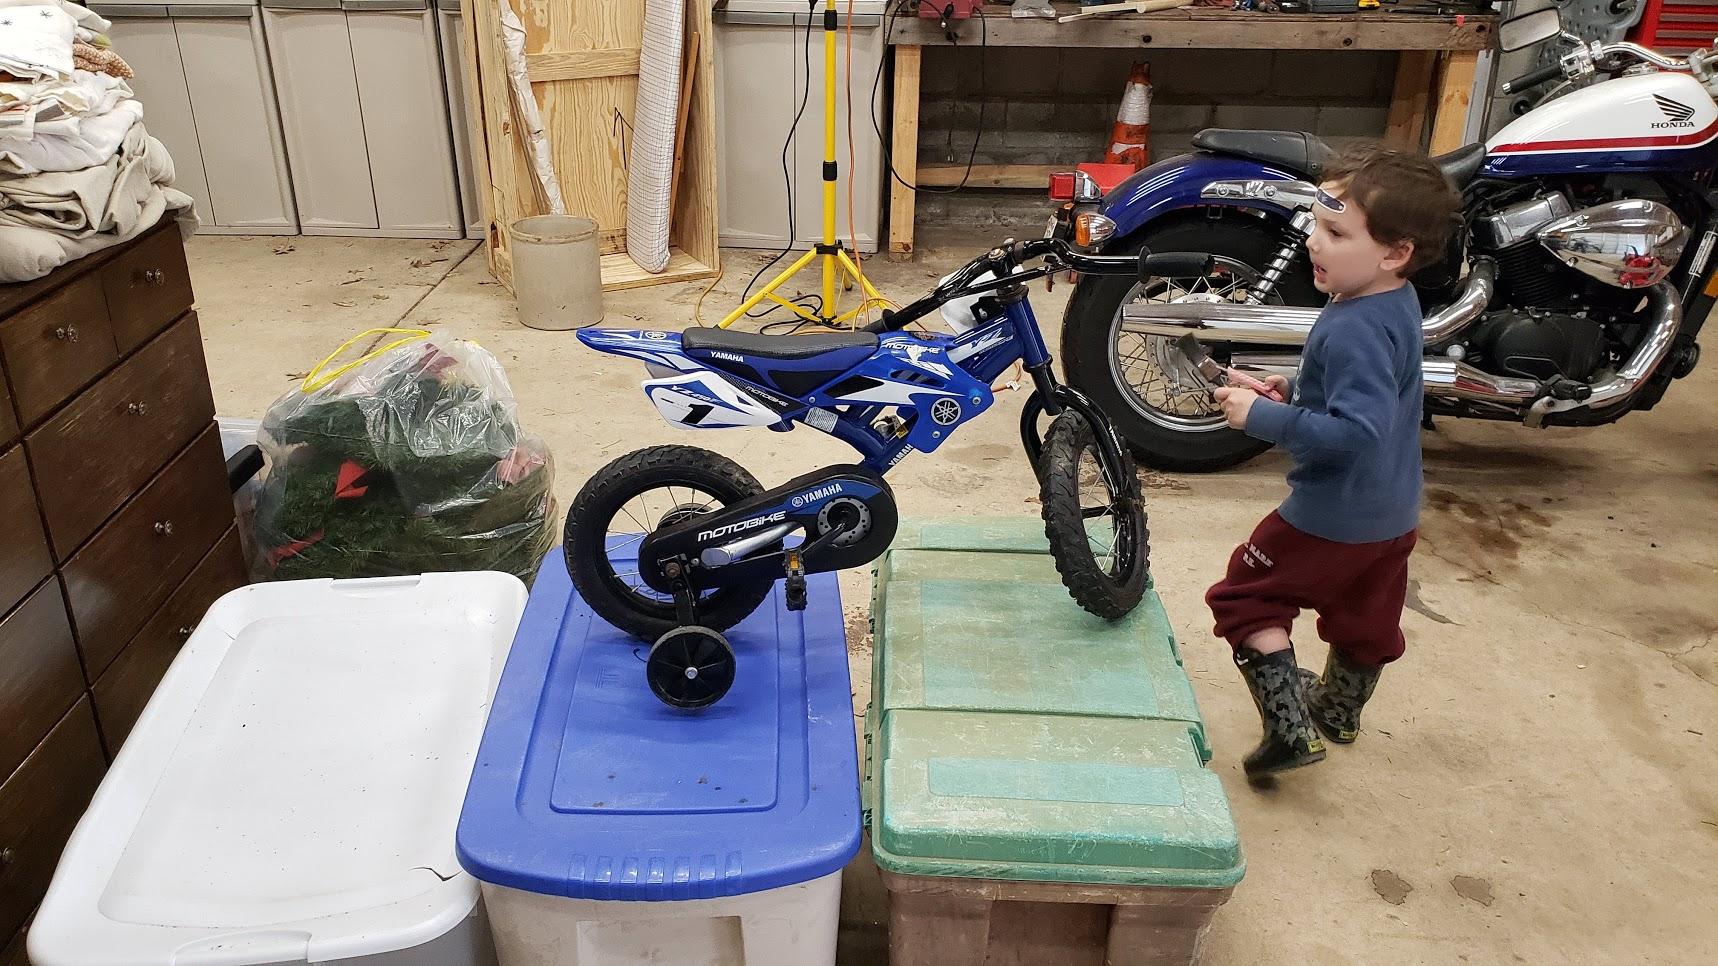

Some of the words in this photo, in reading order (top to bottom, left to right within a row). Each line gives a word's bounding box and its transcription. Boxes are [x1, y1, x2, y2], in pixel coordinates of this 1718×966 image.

[710, 351, 744, 363] YAMAHA
[680, 403, 715, 425] 1
[802, 483, 843, 504] YAMAHA
[697, 510, 787, 542] MOTOBIKE
